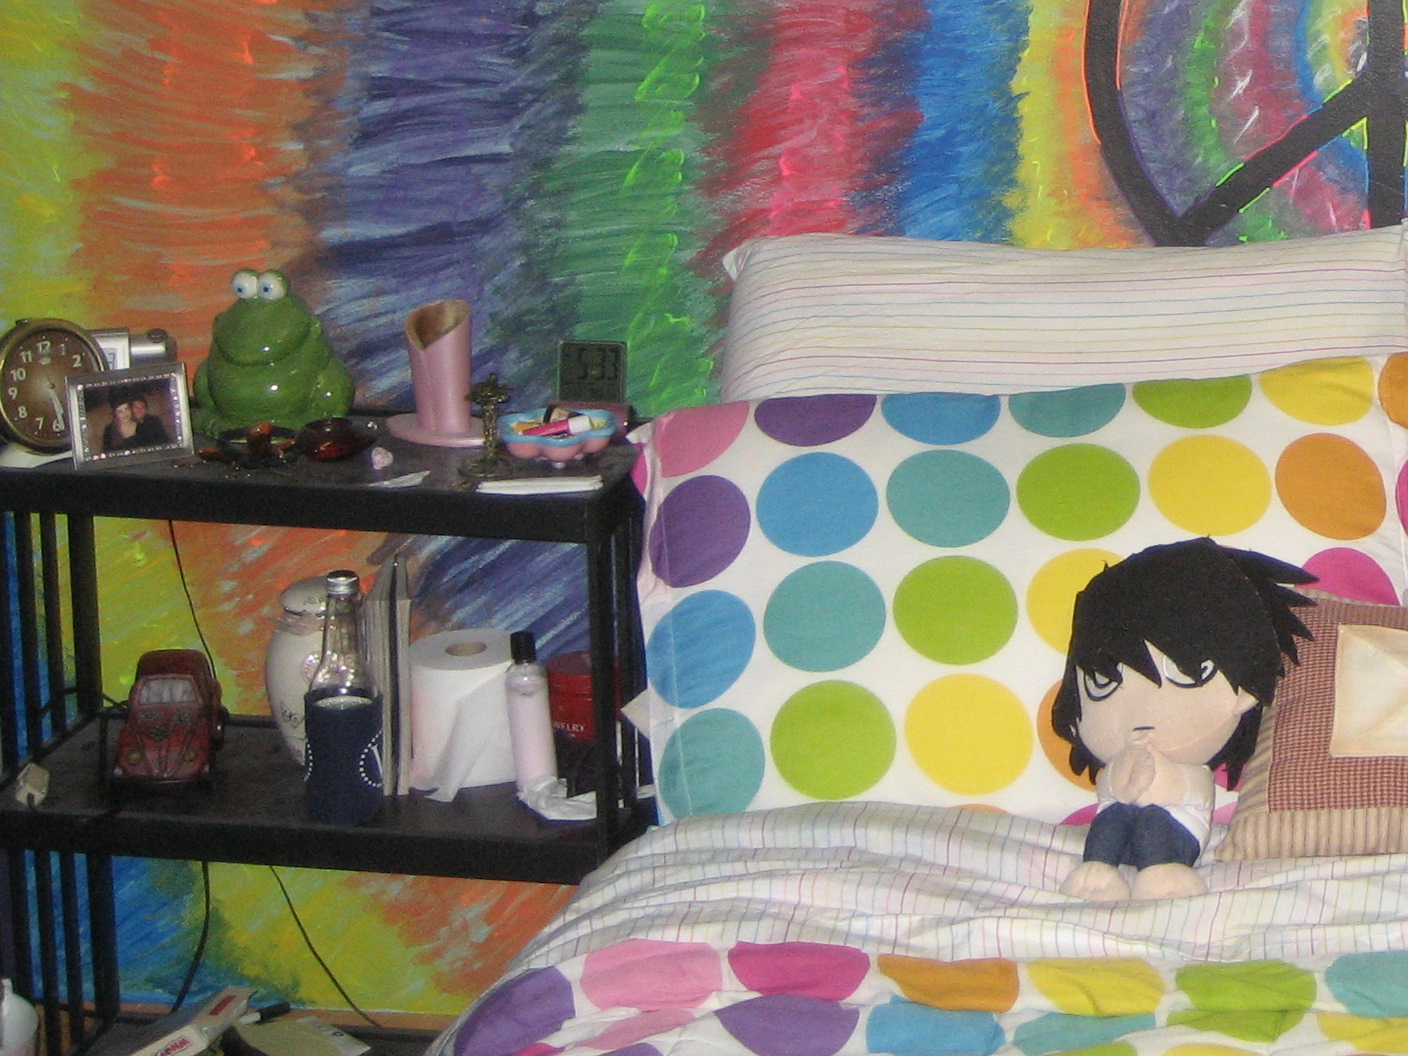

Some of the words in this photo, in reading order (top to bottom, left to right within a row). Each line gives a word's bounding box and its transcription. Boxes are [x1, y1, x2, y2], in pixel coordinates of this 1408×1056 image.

[38, 340, 51, 354] 12
[21, 350, 33, 363] 11
[72, 355, 82, 368] 2
[10, 367, 26, 382] 10
[8, 387, 18, 400] 9
[18, 406, 28, 419] 8
[35, 417, 44, 430] 7
